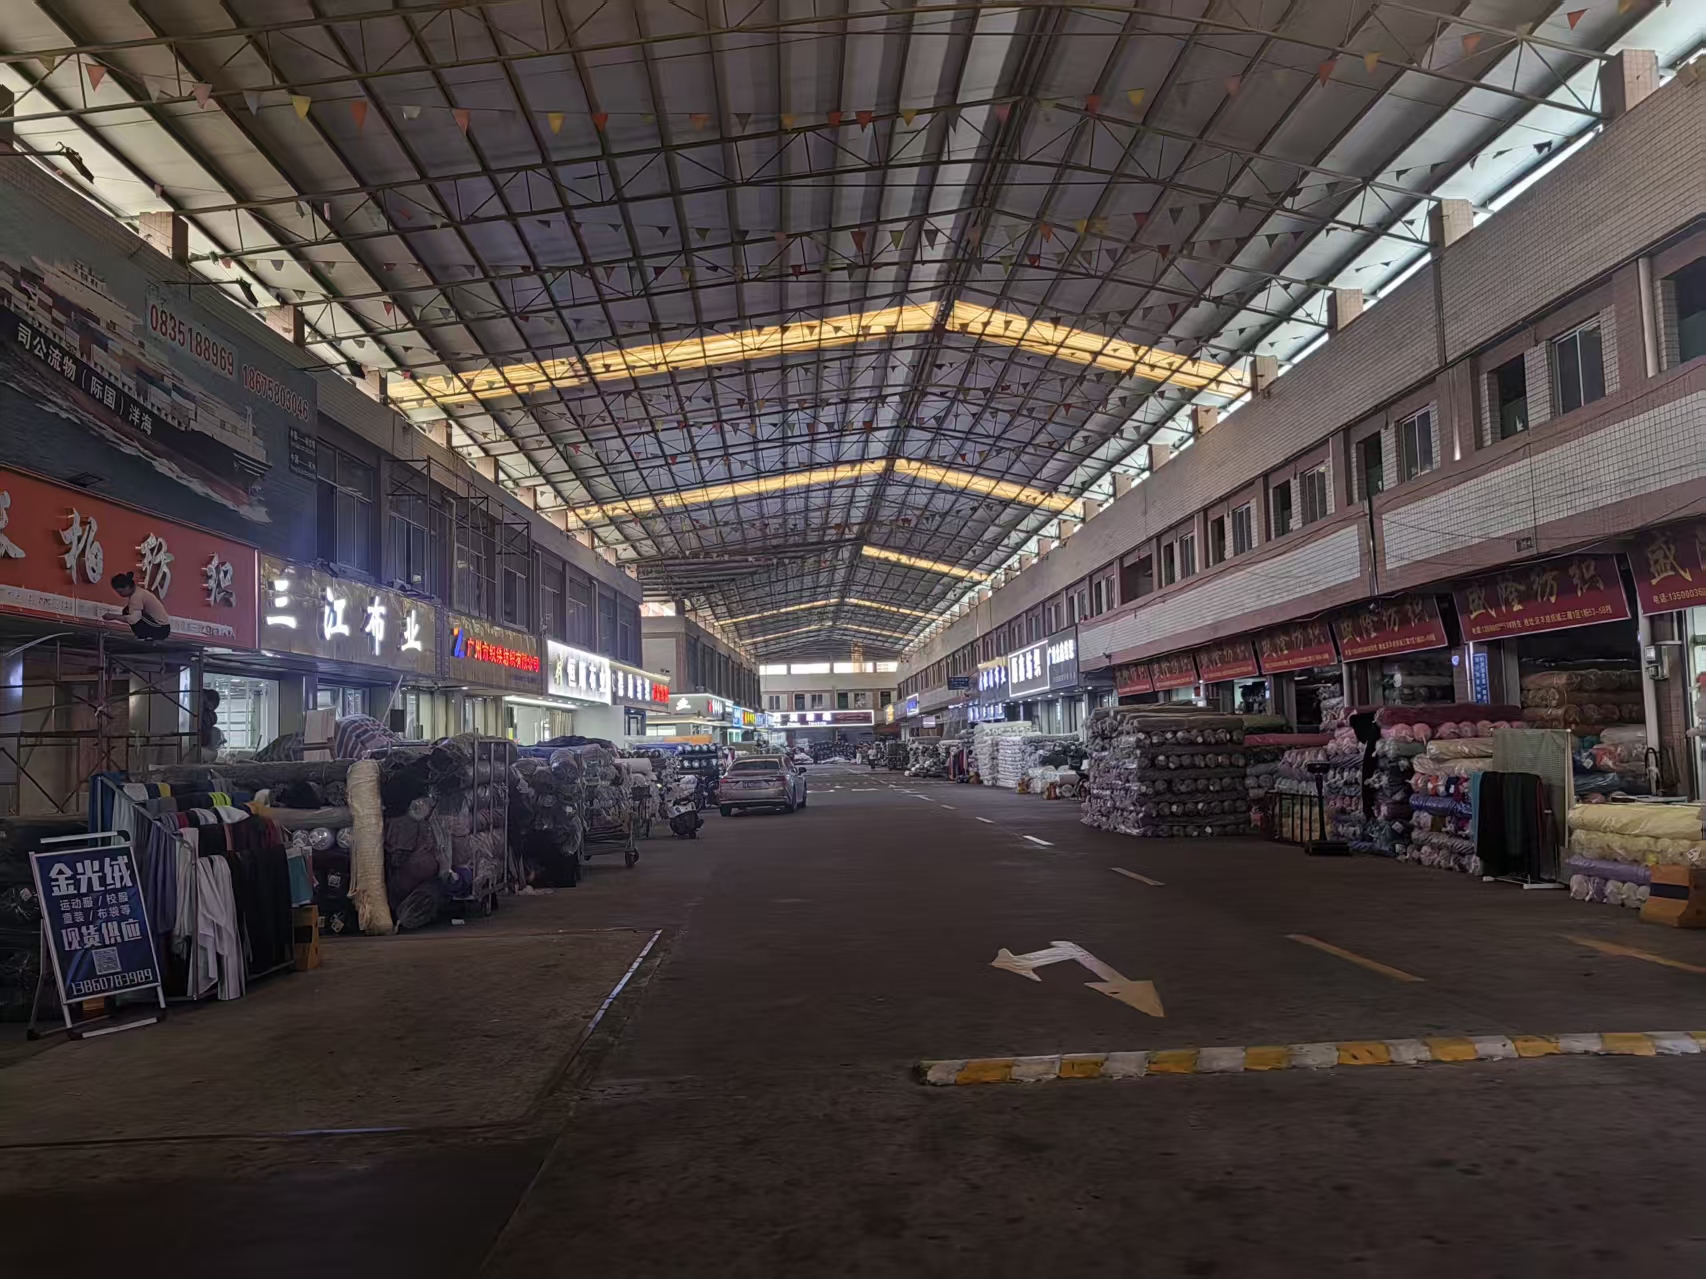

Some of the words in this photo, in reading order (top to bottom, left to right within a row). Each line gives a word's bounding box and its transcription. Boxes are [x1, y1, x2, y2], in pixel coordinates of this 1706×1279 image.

[48, 856, 133, 897] 金光绒
[61, 919, 143, 951] 现货供应
